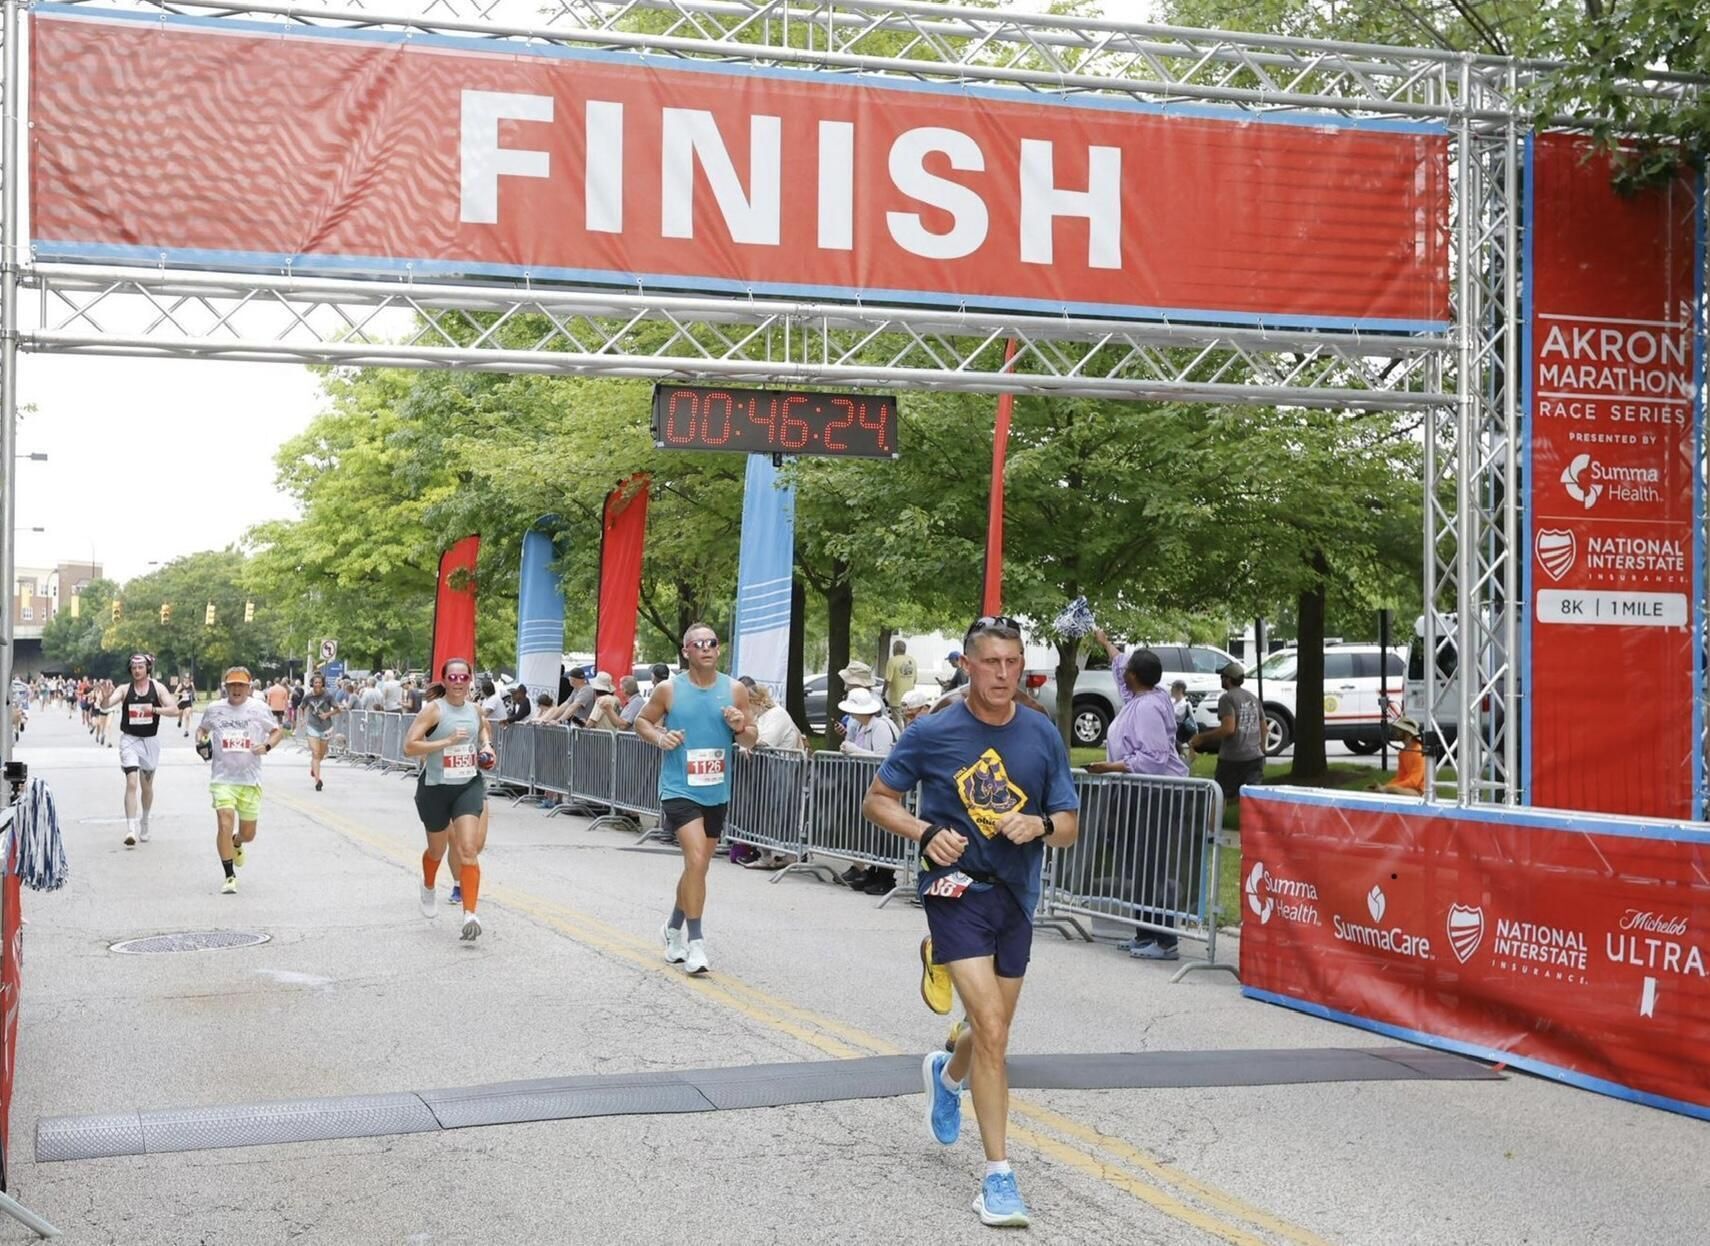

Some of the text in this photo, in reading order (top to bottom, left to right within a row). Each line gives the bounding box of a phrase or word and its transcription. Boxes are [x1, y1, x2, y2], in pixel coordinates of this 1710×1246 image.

[459, 88, 1122, 270] FINISH
[1540, 325, 1685, 367] AKRON
[1539, 364, 1686, 394] MARATHON
[666, 390, 888, 450] 00:46:24
[1539, 402, 1685, 425] RACE SERIES
[1569, 432, 1657, 445] PRESENTED BY
[1591, 461, 1659, 482] Summa
[1609, 484, 1659, 502] Health
[1588, 537, 1684, 557] NATIONAL
[1587, 554, 1685, 572] INTERSTATE
[1588, 573, 1685, 583] INSURANCE
[1561, 599, 1584, 615] 8K
[1622, 602, 1664, 617] MILE
[692, 760, 721, 773] 1126
[1264, 870, 1318, 900] Summa
[1275, 899, 1318, 926] Health
[1619, 908, 1689, 936] Michelob
[1333, 914, 1430, 960] SummaCare
[1496, 918, 1588, 951] NATIONAL
[1494, 938, 1588, 970] INTERSTATE
[1606, 932, 1706, 977] ULTRA
[1491, 959, 1586, 985] INSURANCE
